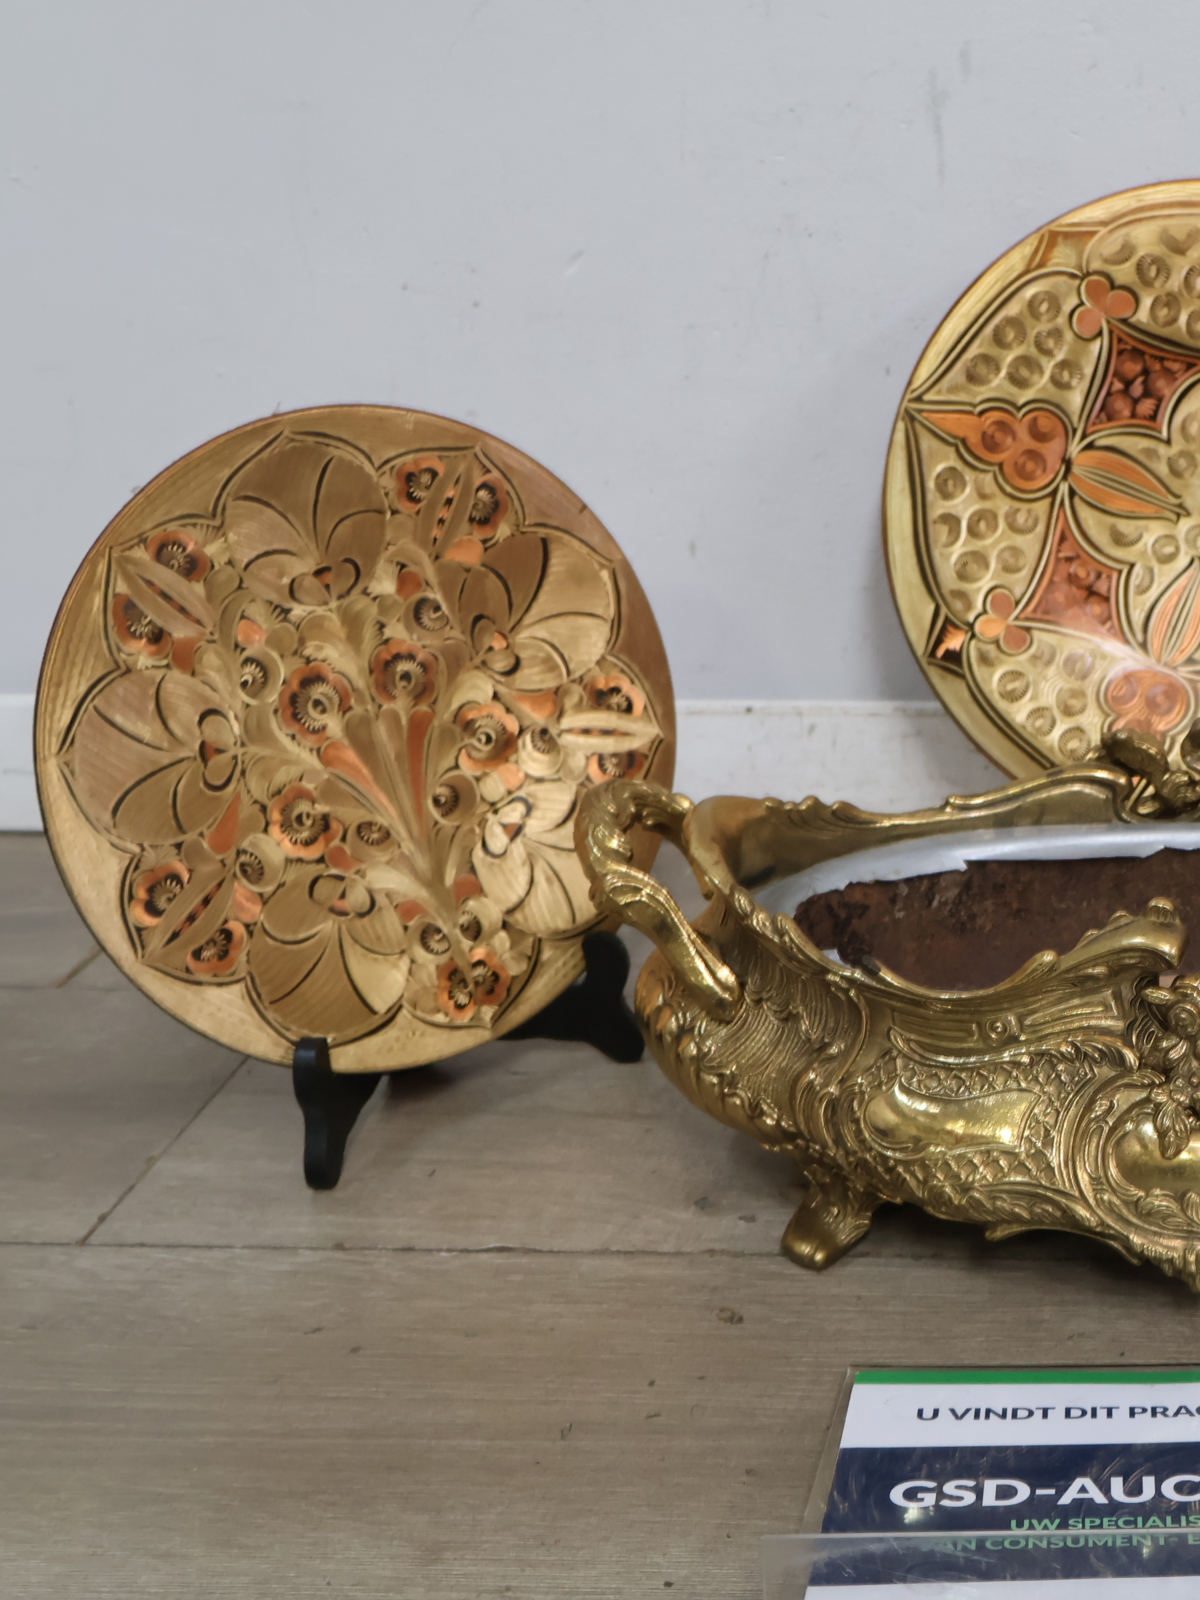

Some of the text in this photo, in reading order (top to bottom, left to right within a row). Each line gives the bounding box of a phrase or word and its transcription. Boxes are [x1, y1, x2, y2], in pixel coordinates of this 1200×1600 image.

[916, 1407, 940, 1421] U
[948, 1406, 1056, 1421] VINDT
[1064, 1405, 1120, 1420] DIT
[1010, 1518, 1060, 1531] UW
